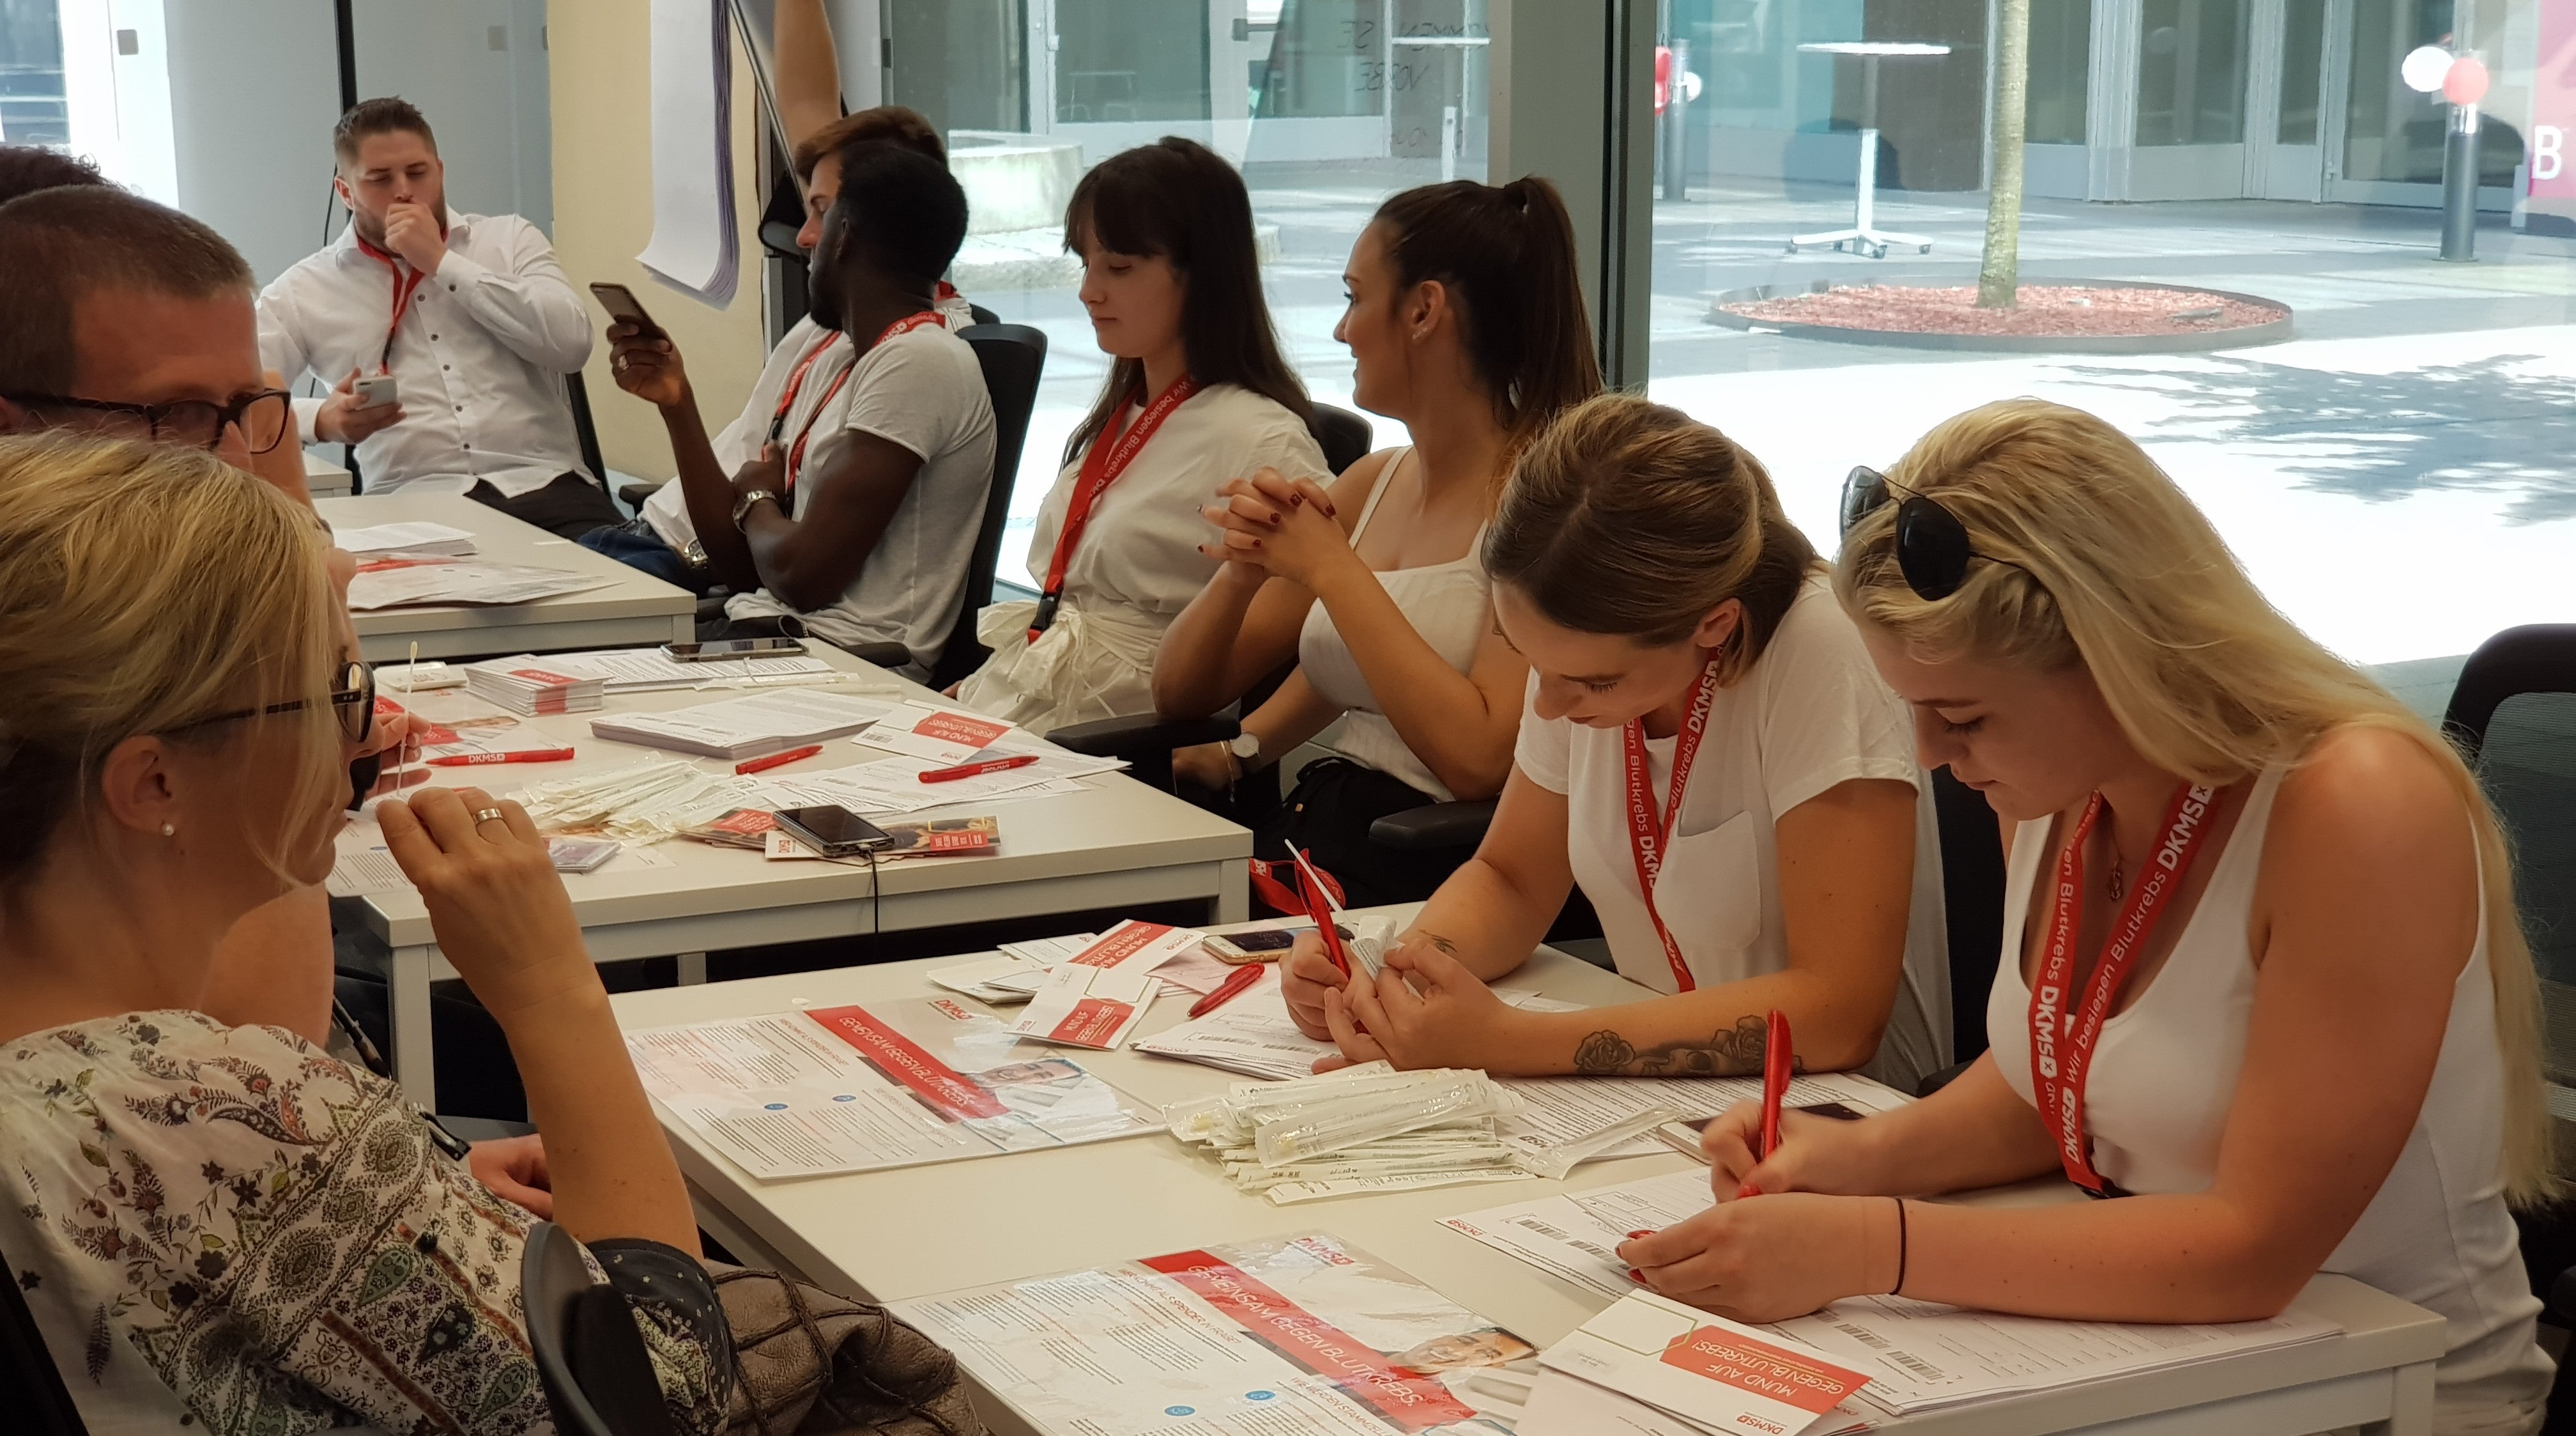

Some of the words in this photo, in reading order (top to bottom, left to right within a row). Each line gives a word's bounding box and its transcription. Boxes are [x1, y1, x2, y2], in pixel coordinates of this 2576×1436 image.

[2532, 125, 2563, 180] B
[1174, 381, 1190, 397] Wir
[1136, 394, 1175, 435] besiegen
[468, 753, 496, 764] DKMS
[1669, 734, 1697, 808] Blutkrebs
[1687, 674, 1717, 735] DKMS
[1630, 754, 1650, 833] Blutkrebs
[2046, 882, 2074, 982] Blutkrebs
[2066, 1049, 2082, 1084] Wir
[2110, 870, 2167, 962] Blutkrebs
[2156, 798, 2205, 872] DKMS
[2034, 985, 2060, 1058] DKMS
[2061, 1102, 2081, 1165] DKMS
[1293, 1237, 1342, 1260] DKMS
[1187, 1265, 1279, 1324] GEMEINSAM
[1271, 1311, 1325, 1355] GEGEN
[1318, 1345, 1426, 1408] BLUTKREBS.
[1690, 1339, 1790, 1378] BLUTKREBS!
[1705, 1363, 1747, 1380] AUF
[1744, 1373, 1799, 1398] MUND
[1788, 1366, 1844, 1395] GEGEN
[1747, 1414, 1785, 1435] DKMS
